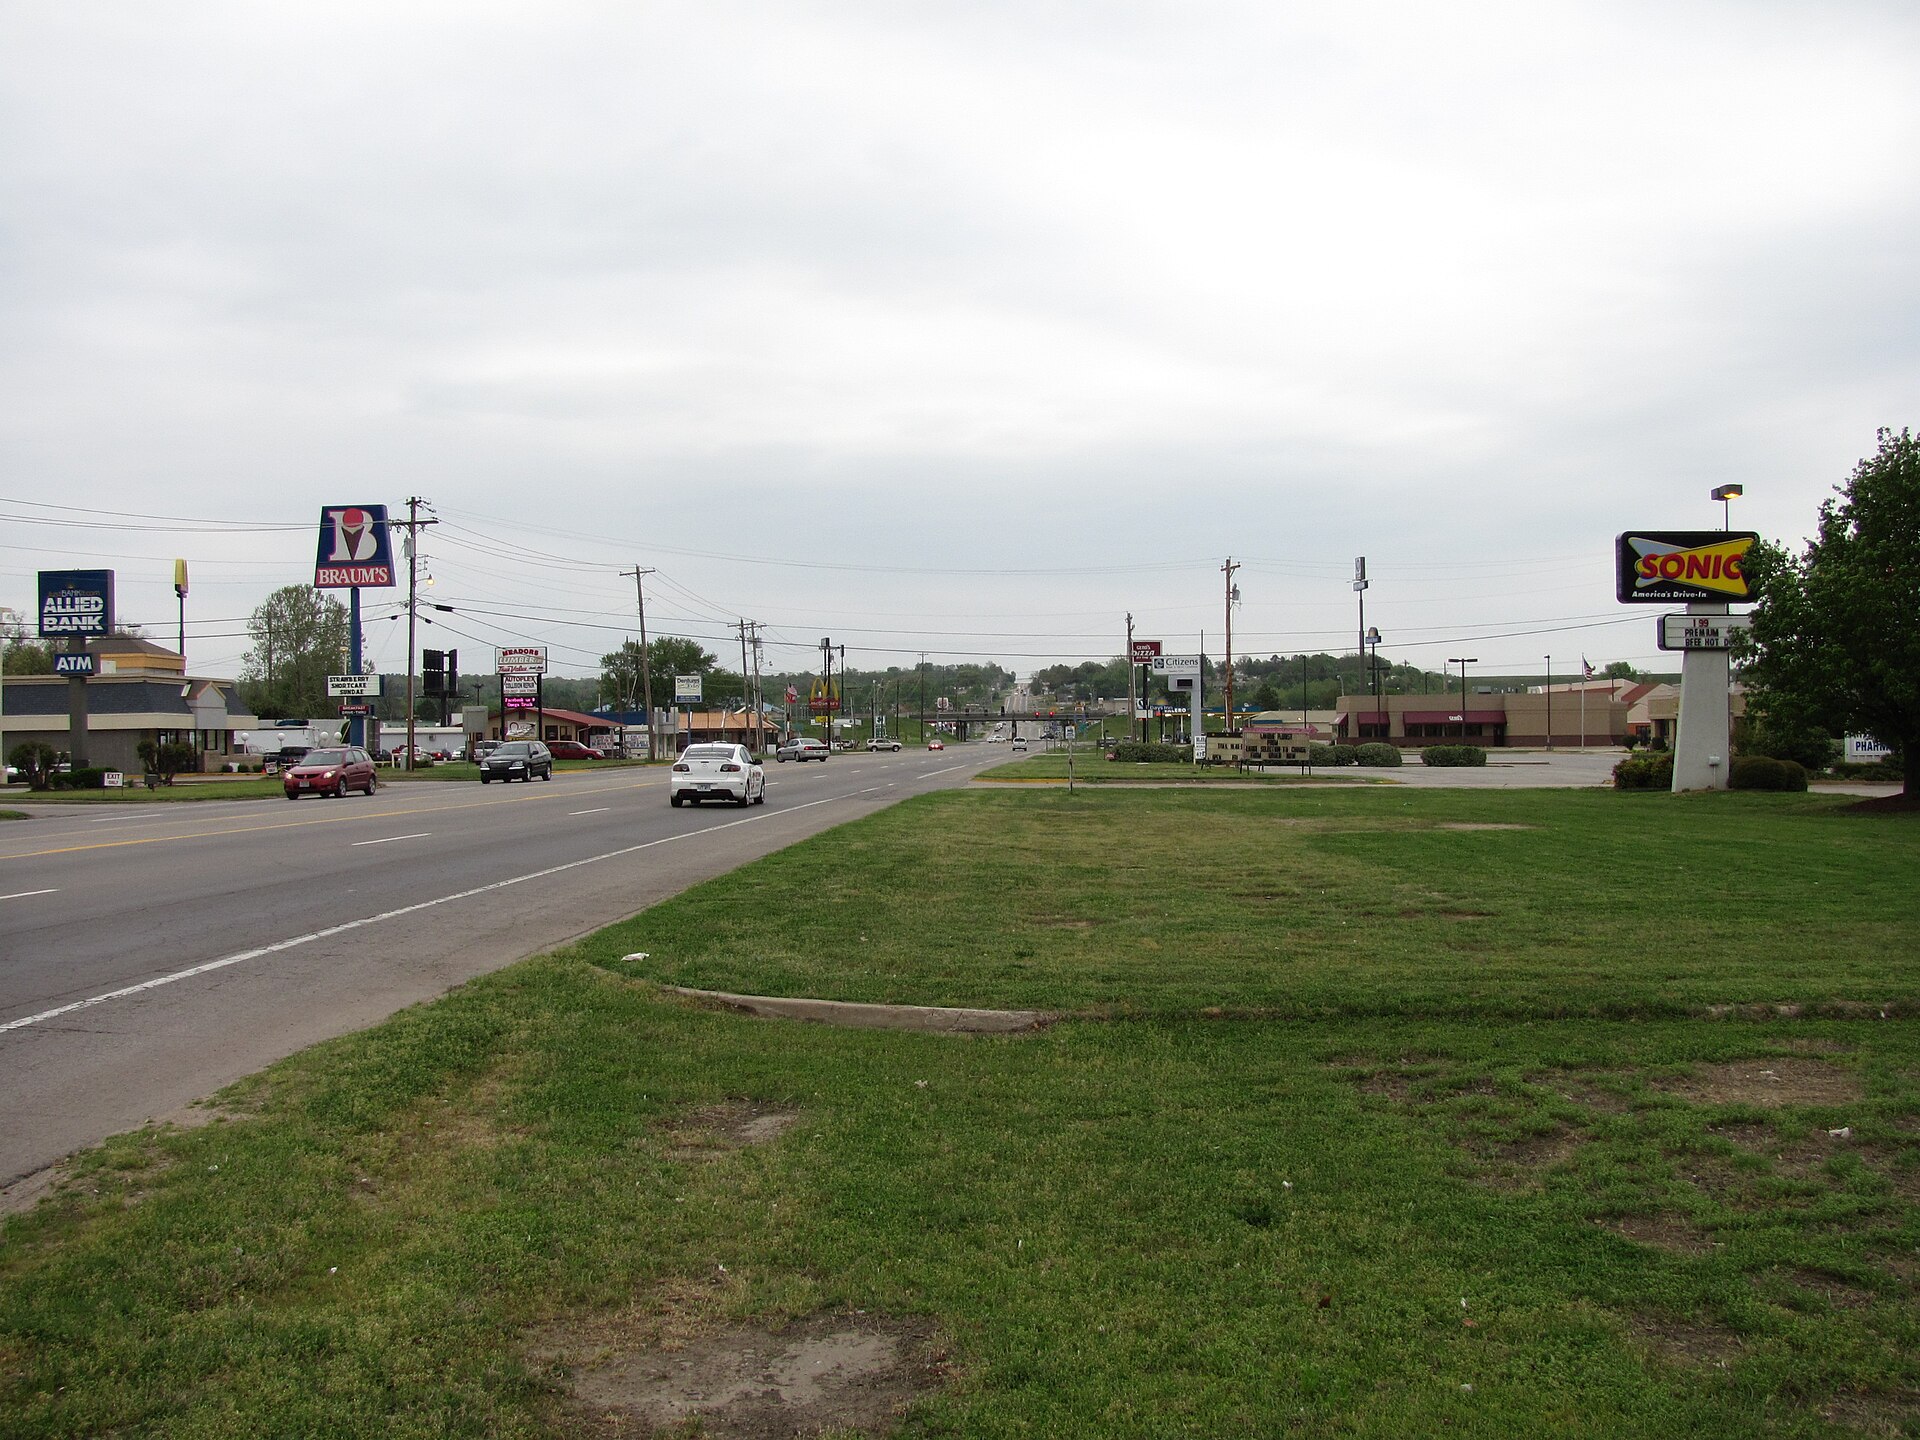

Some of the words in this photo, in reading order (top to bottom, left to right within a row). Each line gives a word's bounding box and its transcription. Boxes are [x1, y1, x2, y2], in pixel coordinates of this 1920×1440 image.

[1640, 553, 1742, 580] SONIC
[319, 567, 388, 584] BRAUM'S
[43, 596, 104, 613] ALLIED
[43, 615, 104, 632] BANK
[1685, 629, 1719, 637] PREMIUM
[56, 656, 93, 670] ATM
[1166, 657, 1199, 666] Citizens
